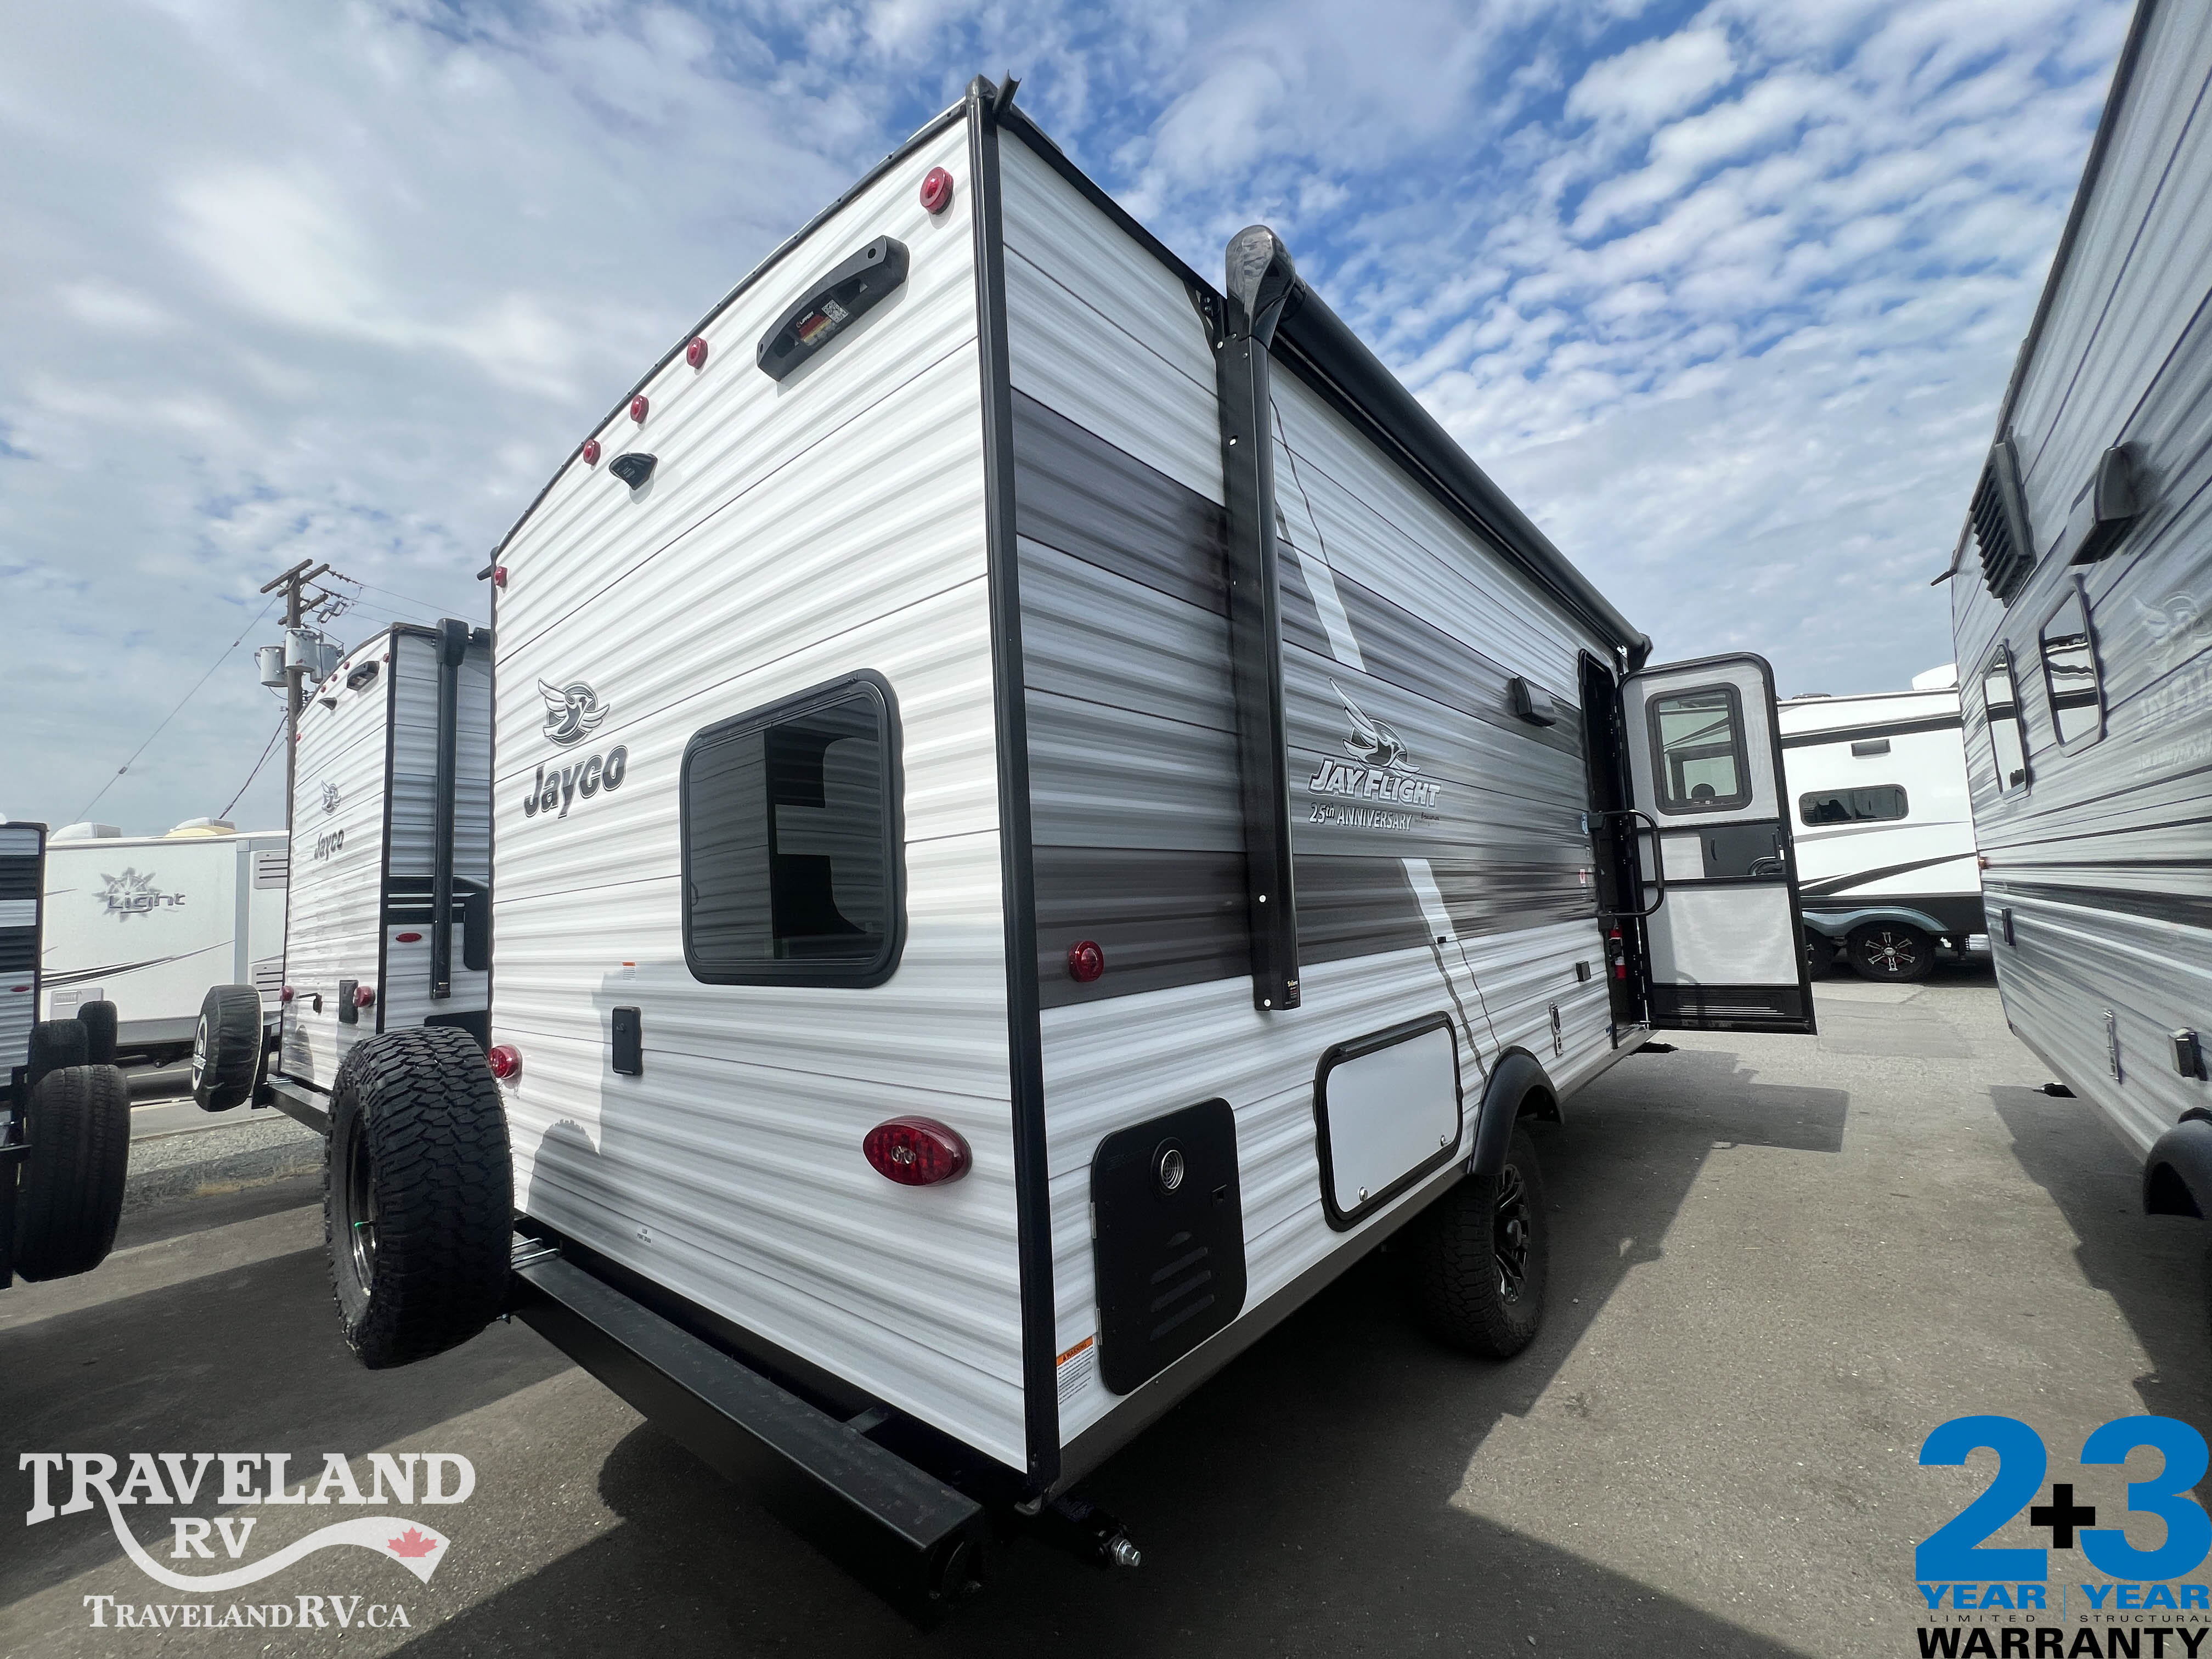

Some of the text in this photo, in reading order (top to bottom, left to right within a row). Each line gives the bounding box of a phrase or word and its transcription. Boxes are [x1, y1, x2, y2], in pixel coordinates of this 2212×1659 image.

[523, 744, 629, 820] Jayco
[1309, 759, 1441, 807] JAY FLIGHT
[1308, 803, 1335, 823] 25th
[1336, 805, 1413, 831] ANNIVERSARY
[314, 828, 345, 861] Jayco
